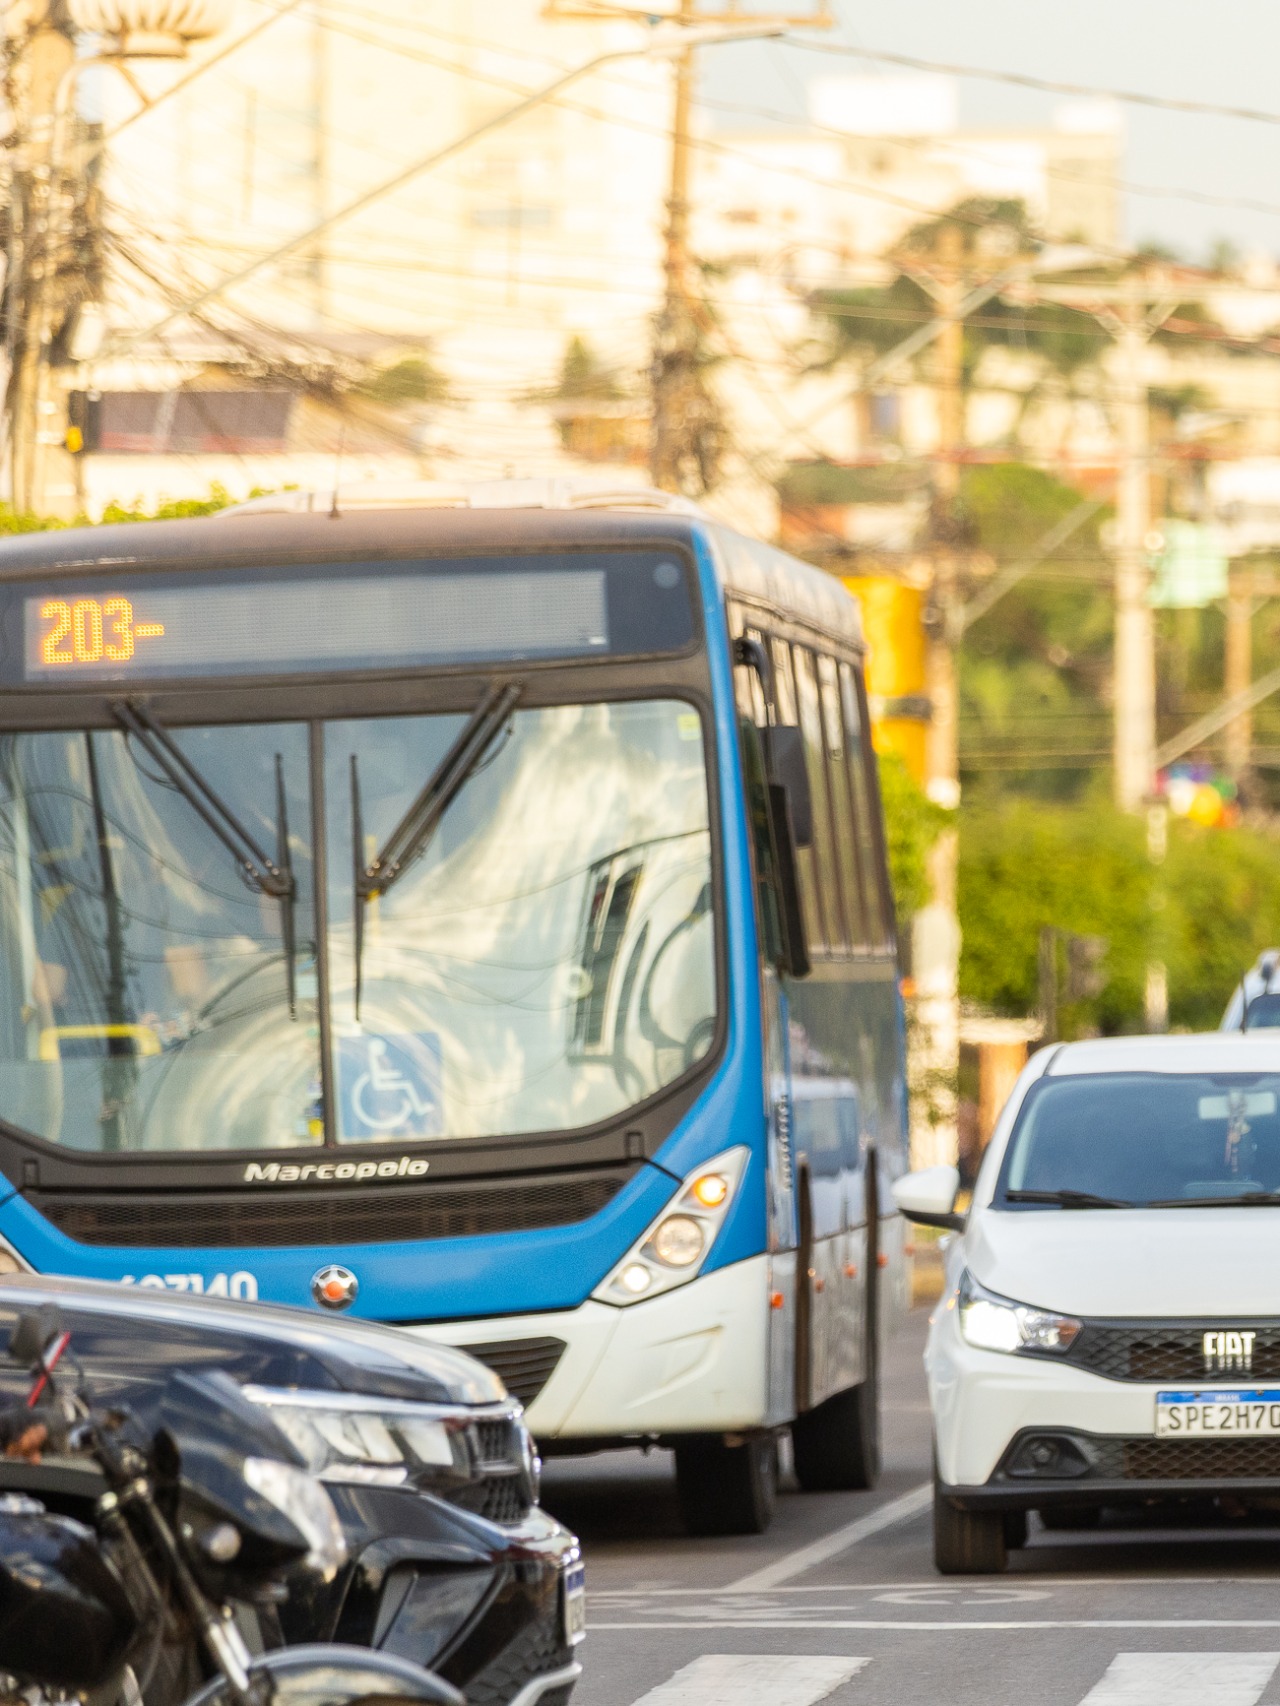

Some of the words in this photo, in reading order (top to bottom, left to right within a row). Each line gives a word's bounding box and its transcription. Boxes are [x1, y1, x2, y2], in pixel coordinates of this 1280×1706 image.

[42, 598, 165, 664] 203-
[244, 1155, 430, 1183] Marcopolo
[1203, 1331, 1256, 1357] FIAT
